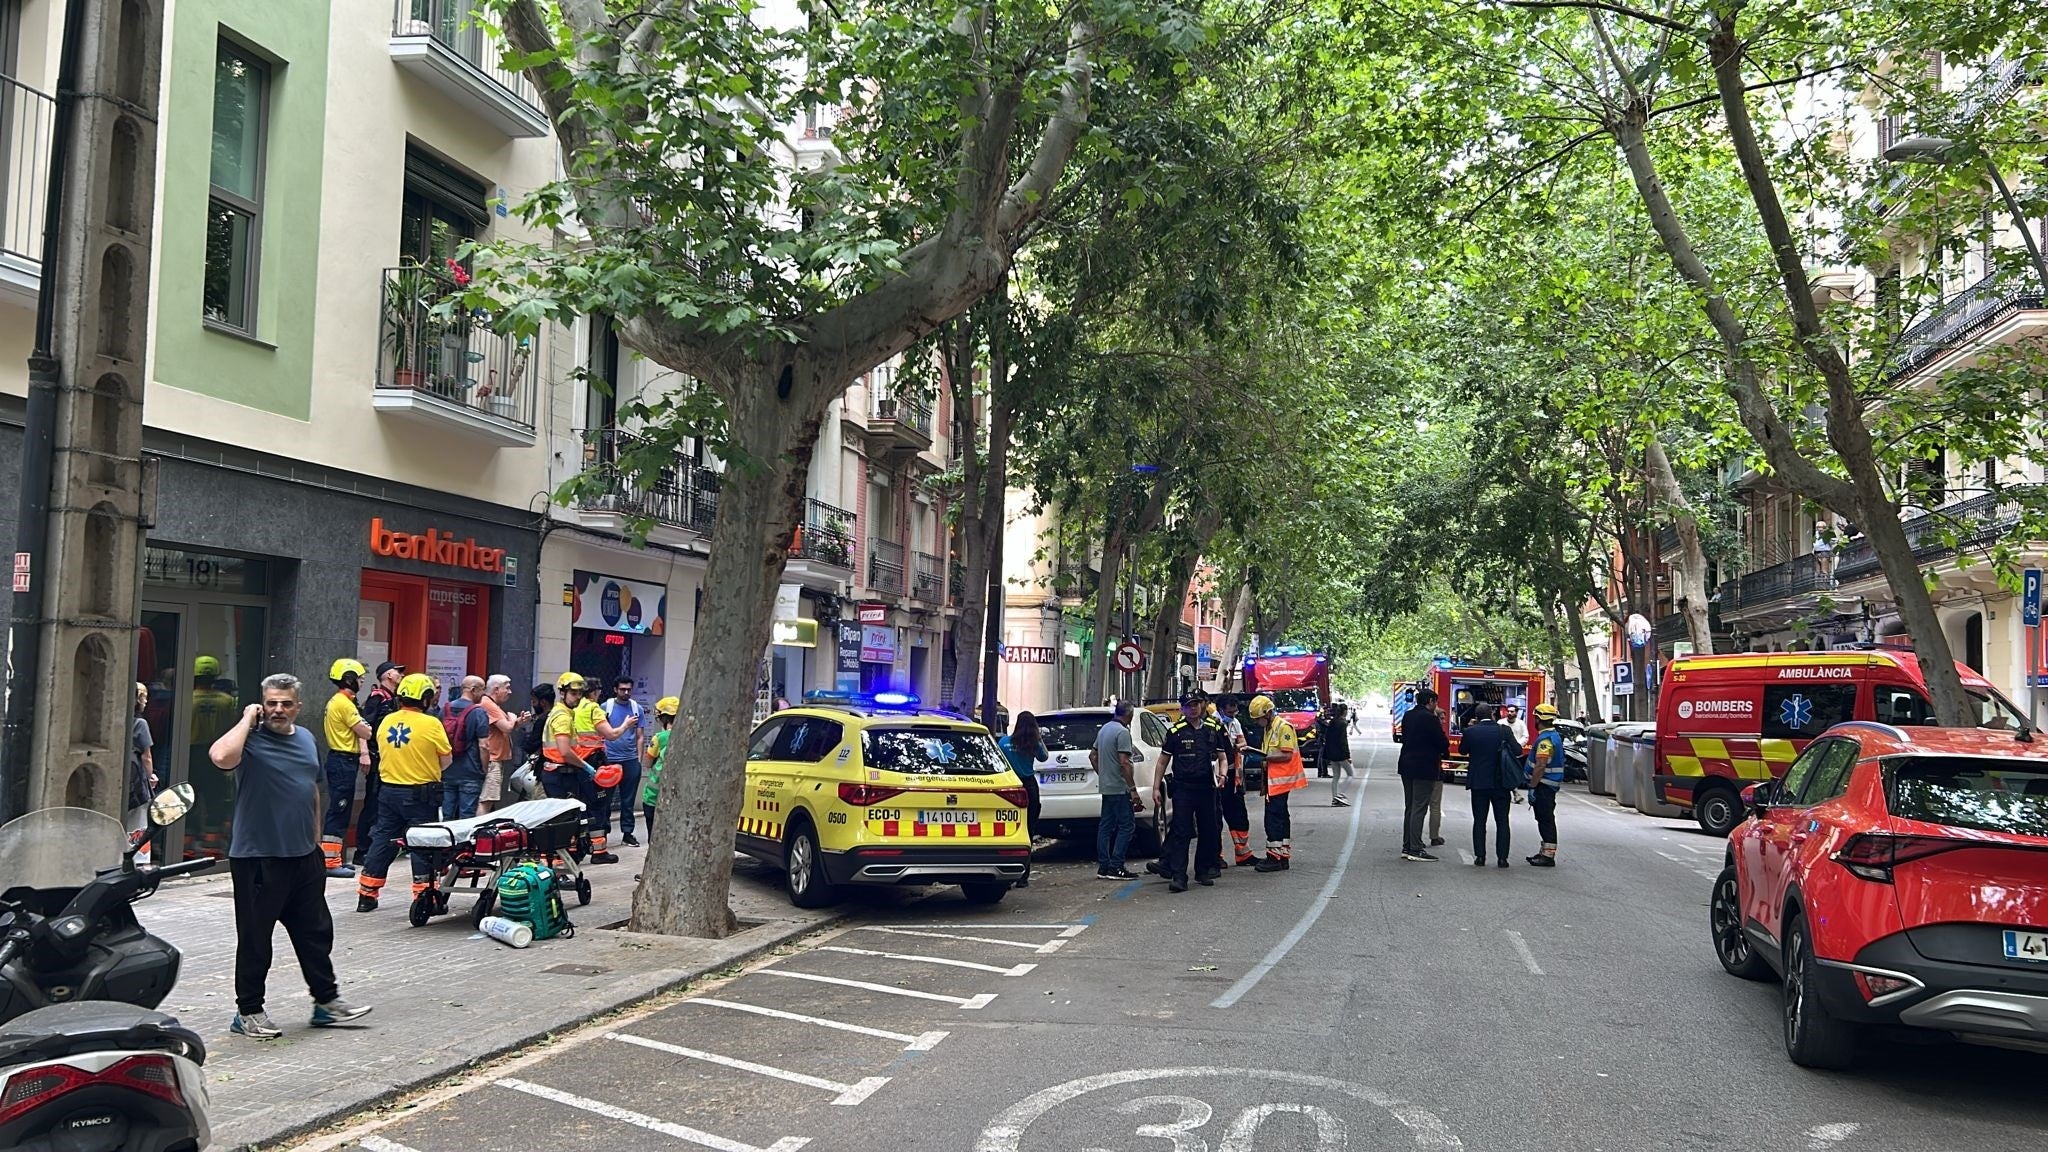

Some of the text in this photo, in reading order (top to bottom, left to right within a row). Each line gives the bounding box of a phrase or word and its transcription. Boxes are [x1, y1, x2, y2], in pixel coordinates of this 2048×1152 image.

[187, 558, 219, 586] 181
[2028, 577, 2037, 597] P
[1616, 665, 1629, 682] P
[1778, 666, 1852, 679] AMBULÀNCIA
[1695, 700, 1753, 712] BOMBERS
[1069, 773, 1085, 782] GFZ
[828, 811, 847, 825] 0500
[868, 809, 901, 820] ECO-0
[926, 811, 975, 823] 1410 LGJ
[995, 809, 1019, 822] 0500
[72, 1116, 111, 1128] KYMCO
[1082, 1095, 1347, 1152] 30
